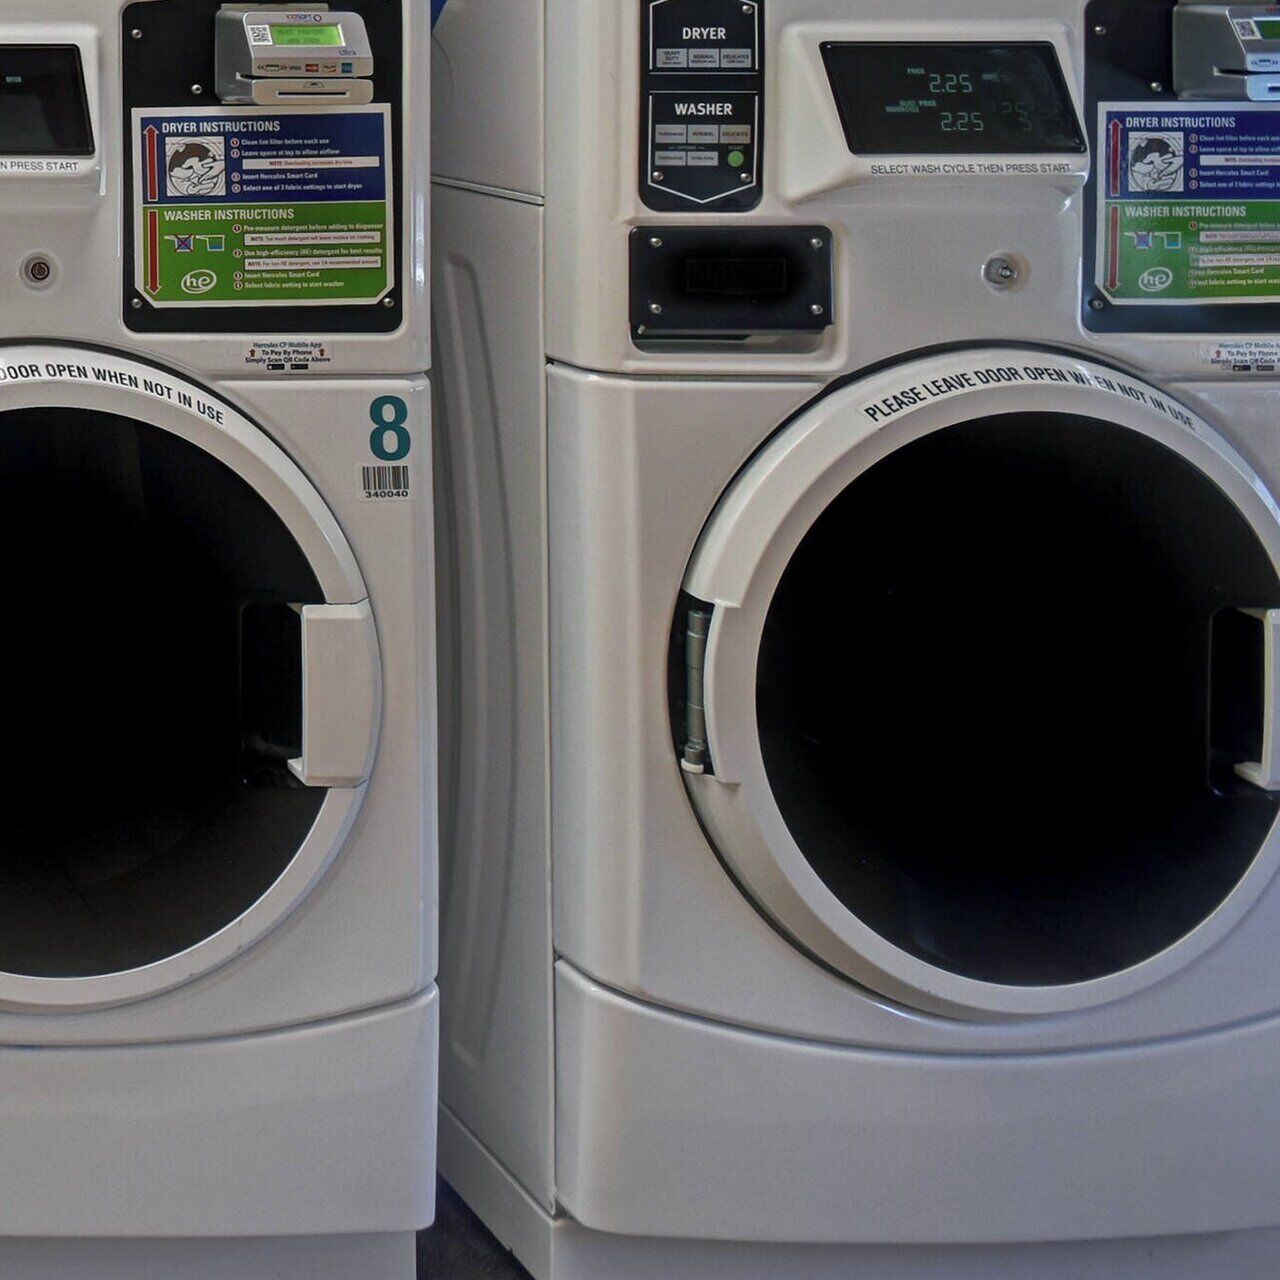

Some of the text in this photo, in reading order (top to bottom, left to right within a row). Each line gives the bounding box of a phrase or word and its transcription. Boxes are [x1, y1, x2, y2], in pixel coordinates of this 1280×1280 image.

[682, 27, 726, 39] DRYER
[929, 74, 973, 93] 2.25
[675, 103, 732, 115] WASHER
[162, 122, 281, 133] DRYER INSTRUCTIONS
[941, 112, 984, 131] 2.25
[1126, 117, 1236, 128] DRYER INSTRUCTIONS
[10, 161, 44, 170] PRESS
[45, 161, 79, 171] START
[871, 163, 1071, 175] SELECT WASH CYCLE THEN PRESS START
[164, 209, 294, 220] WASHER INSTRUCTIONS
[1125, 206, 1246, 217] WASHER INSTRUCTIONS
[45, 363, 88, 379] OPEN
[91, 367, 139, 389] WHEN
[143, 379, 173, 399] NOT
[178, 391, 192, 409] IN
[197, 400, 224, 425] USE
[864, 386, 927, 422] PLEASE
[922, 373, 977, 397] LEAVE
[973, 367, 1024, 385] DOOR
[1023, 366, 1069, 382] OPEN
[1117, 384, 1148, 404] NOT
[1149, 395, 1167, 413] IN
[369, 395, 411, 461] 8
[365, 490, 408, 498] 340040
